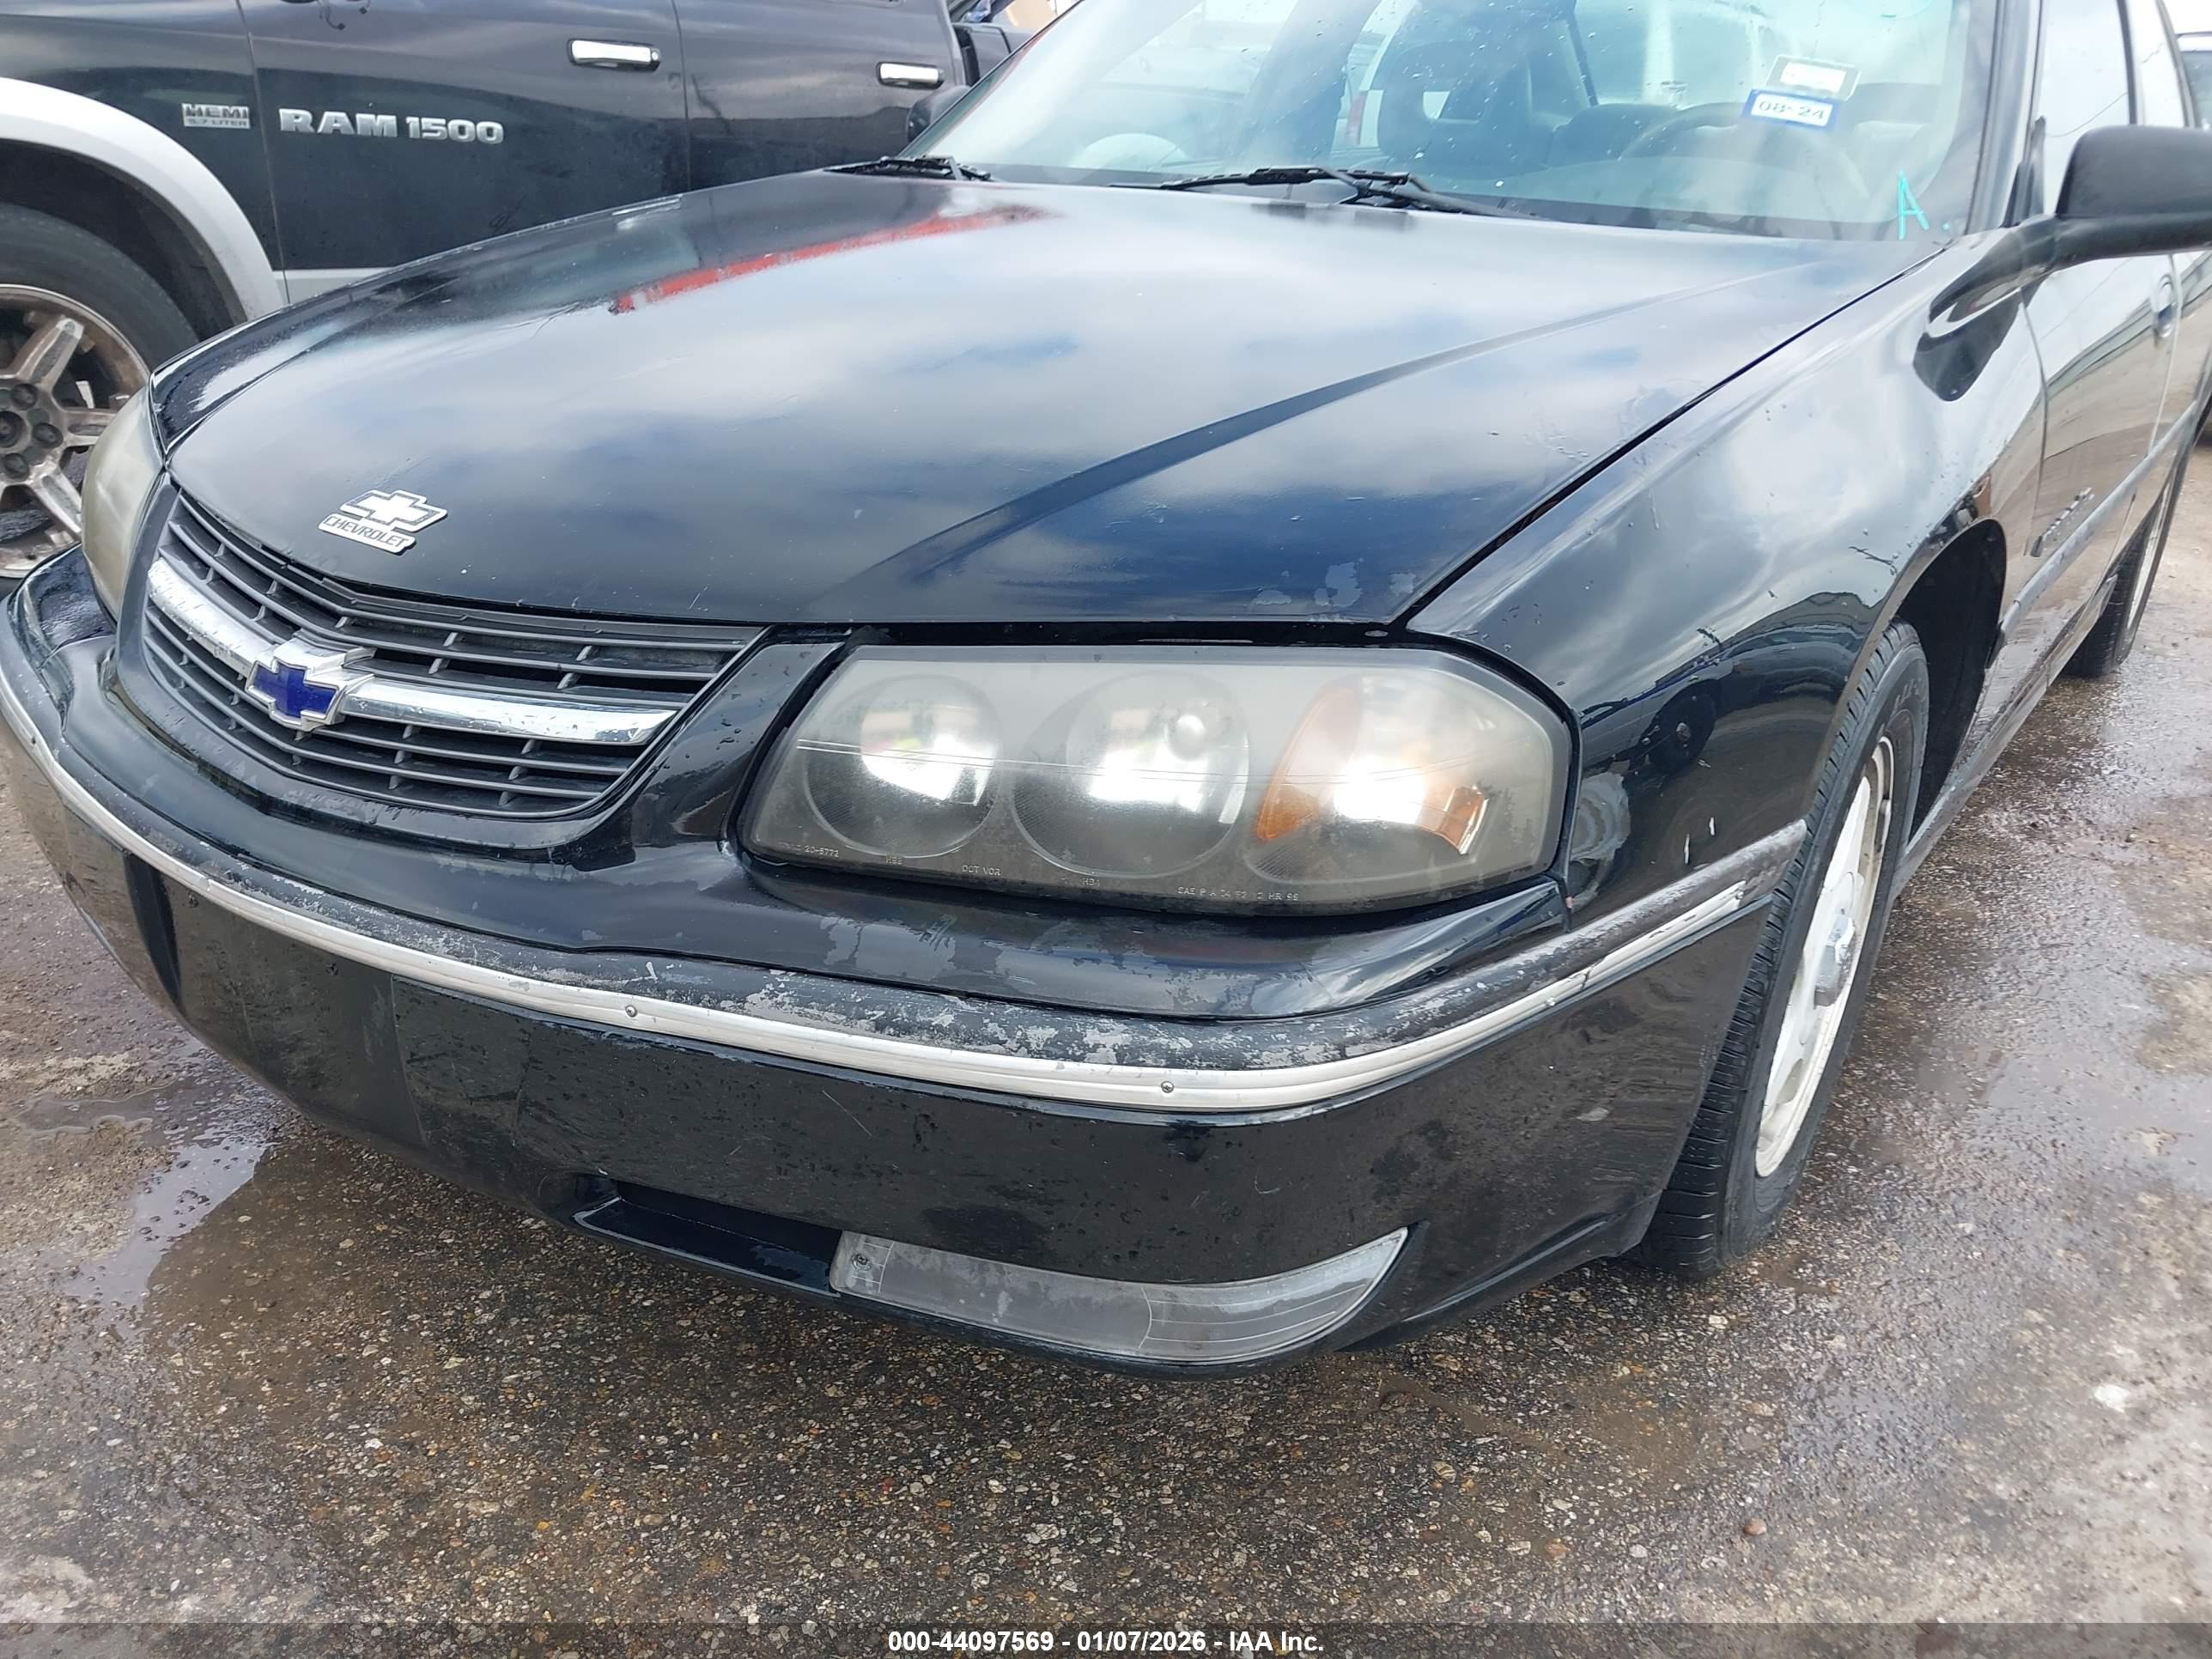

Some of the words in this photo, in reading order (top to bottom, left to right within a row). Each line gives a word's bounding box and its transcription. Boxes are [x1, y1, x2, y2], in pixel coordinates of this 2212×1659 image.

[184, 104, 248, 118] HEMI
[279, 108, 398, 137] RAM
[405, 116, 504, 144] 1500
[323, 515, 410, 548] CHEVROLET
